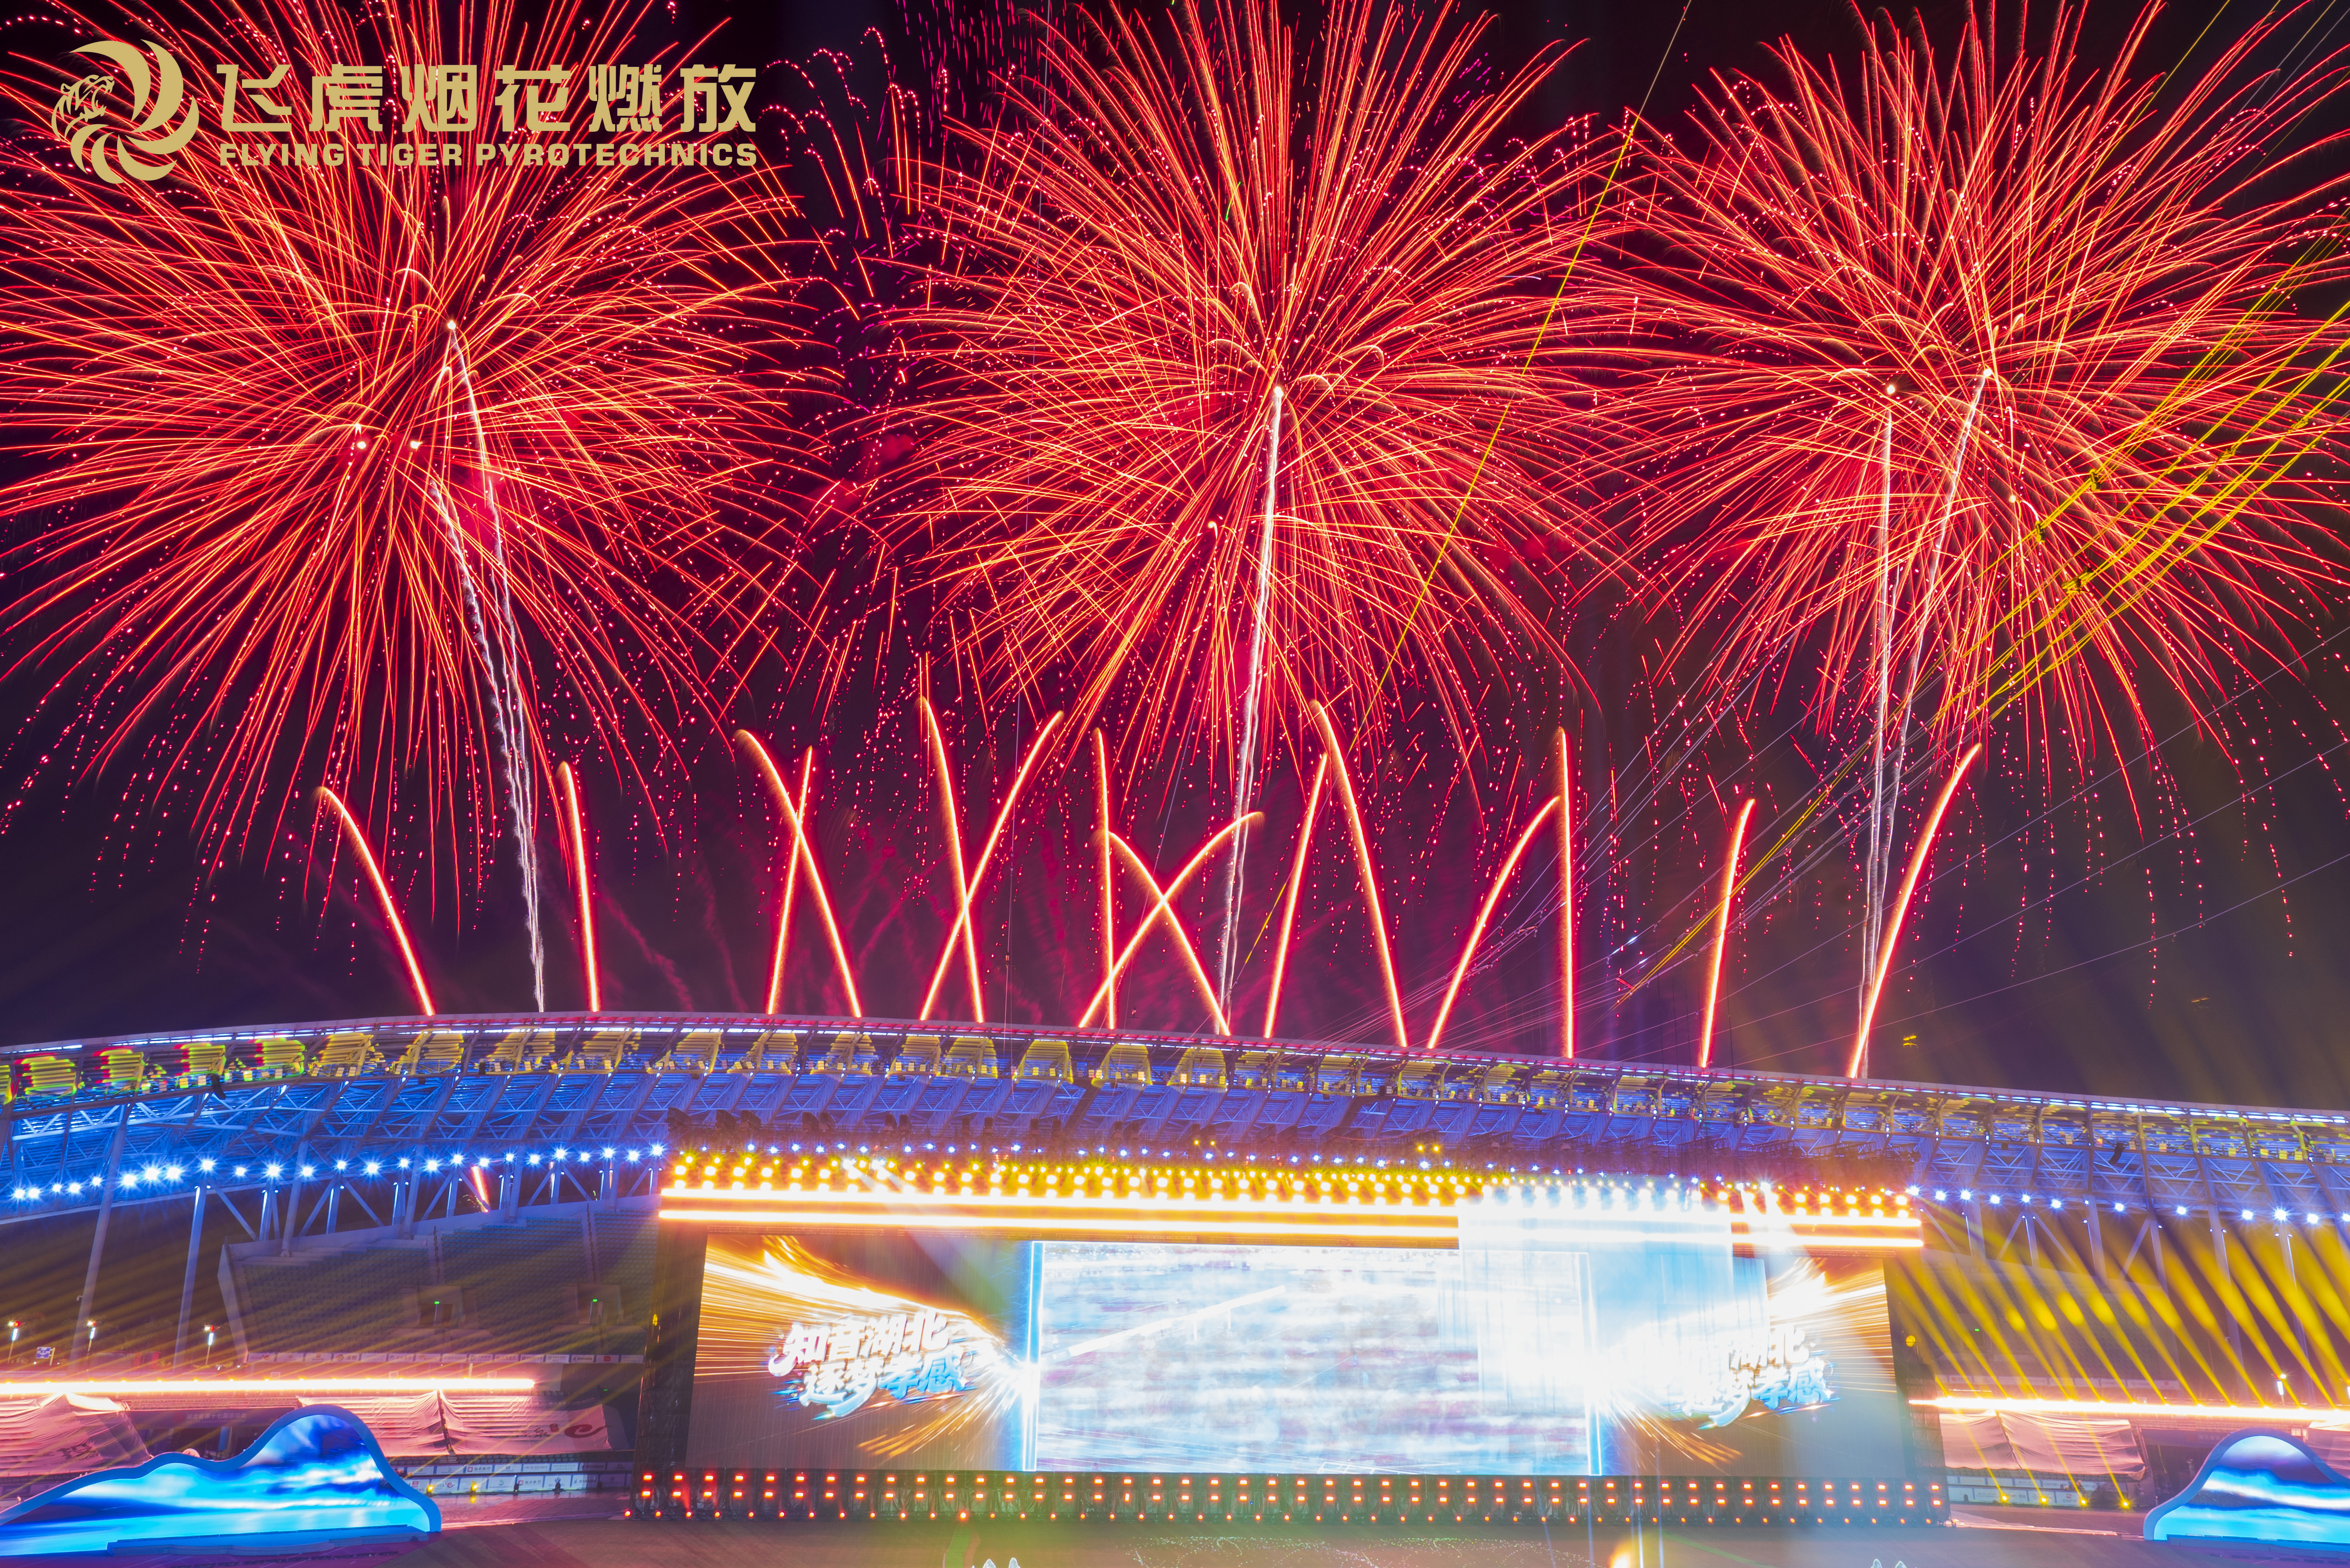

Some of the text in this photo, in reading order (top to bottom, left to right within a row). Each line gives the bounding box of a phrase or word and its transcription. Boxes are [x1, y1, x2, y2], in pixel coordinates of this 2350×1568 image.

[768, 1310, 949, 1377] 知音湖北
[799, 1344, 966, 1417] 逐梦孝感
